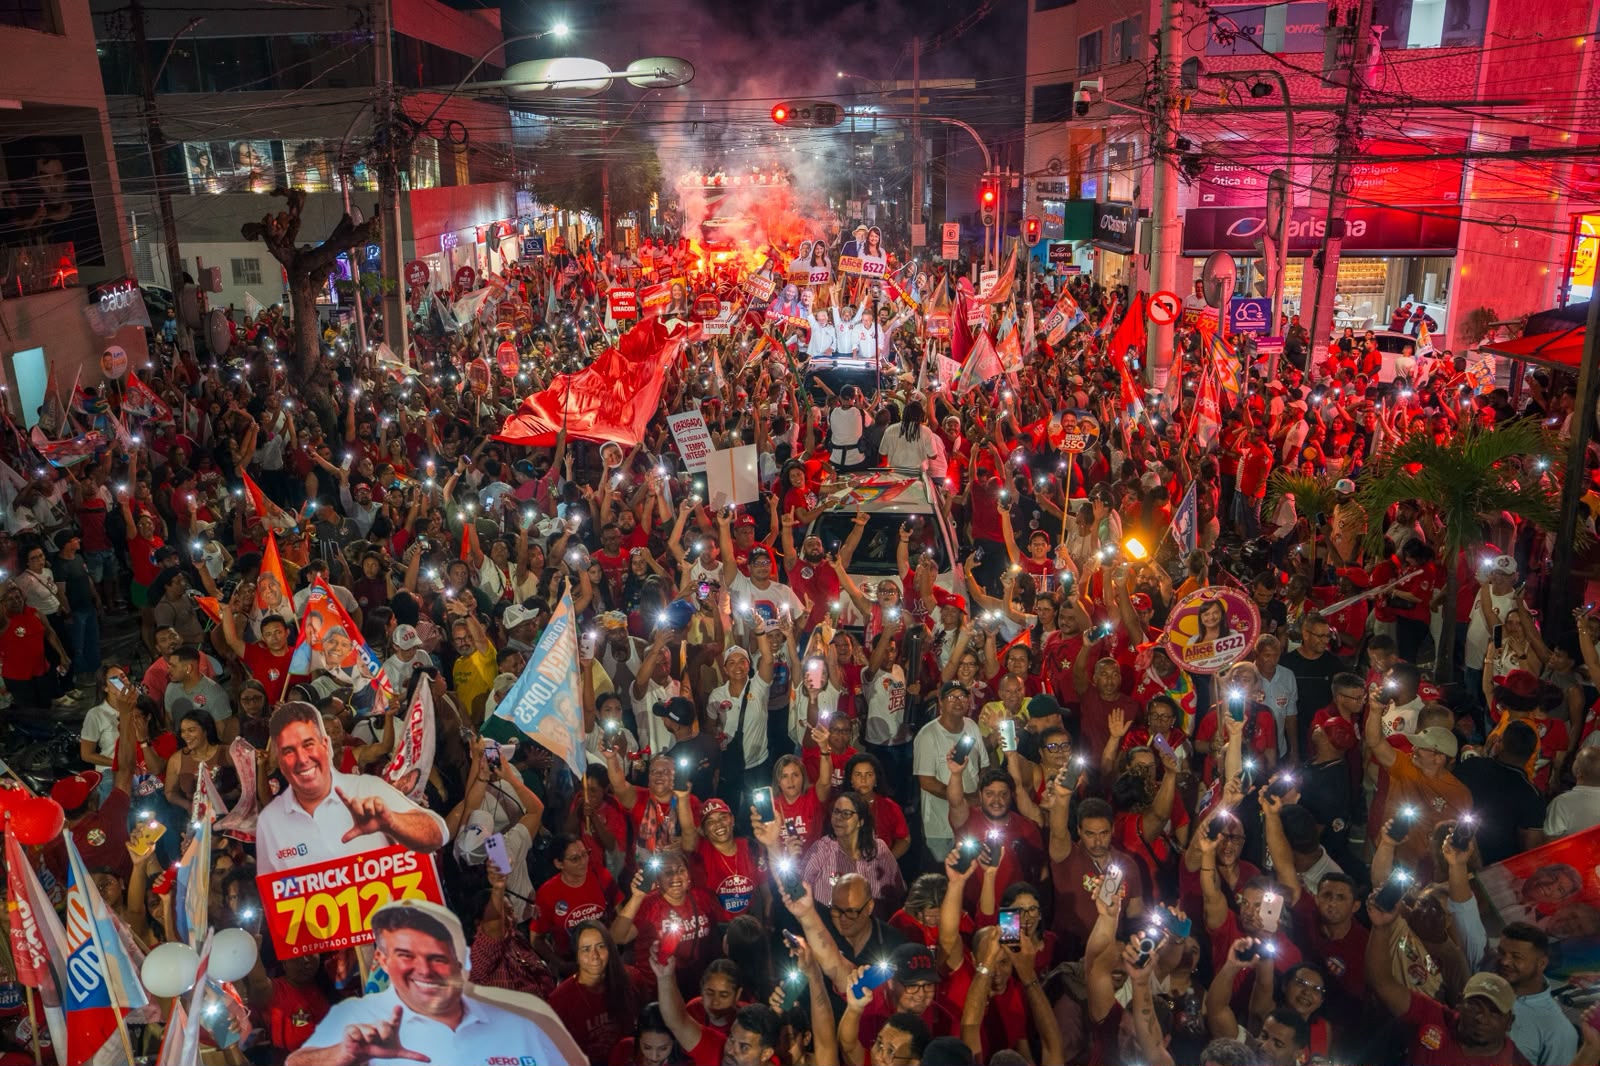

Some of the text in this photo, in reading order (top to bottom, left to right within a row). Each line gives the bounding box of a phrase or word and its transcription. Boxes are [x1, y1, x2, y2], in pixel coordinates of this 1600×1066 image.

[1288, 216, 1367, 238] arisa
[840, 257, 885, 274] Alice 6522
[809, 271, 830, 283] 6522
[672, 417, 703, 433] OBRIGADO
[685, 441, 707, 452] TEMPO
[1059, 439, 1086, 450] 1350
[1185, 643, 1213, 658] Alice
[1215, 635, 1244, 653] 6522
[702, 802, 722, 815] LULA
[276, 847, 298, 859] JERO
[271, 850, 418, 900] PATRICK LOPES
[275, 871, 428, 946] 70123
[725, 899, 749, 911] BRITO
[292, 946, 300, 955] O
[302, 937, 348, 953] DEPUTADO
[488, 1056, 520, 1066] JERO
